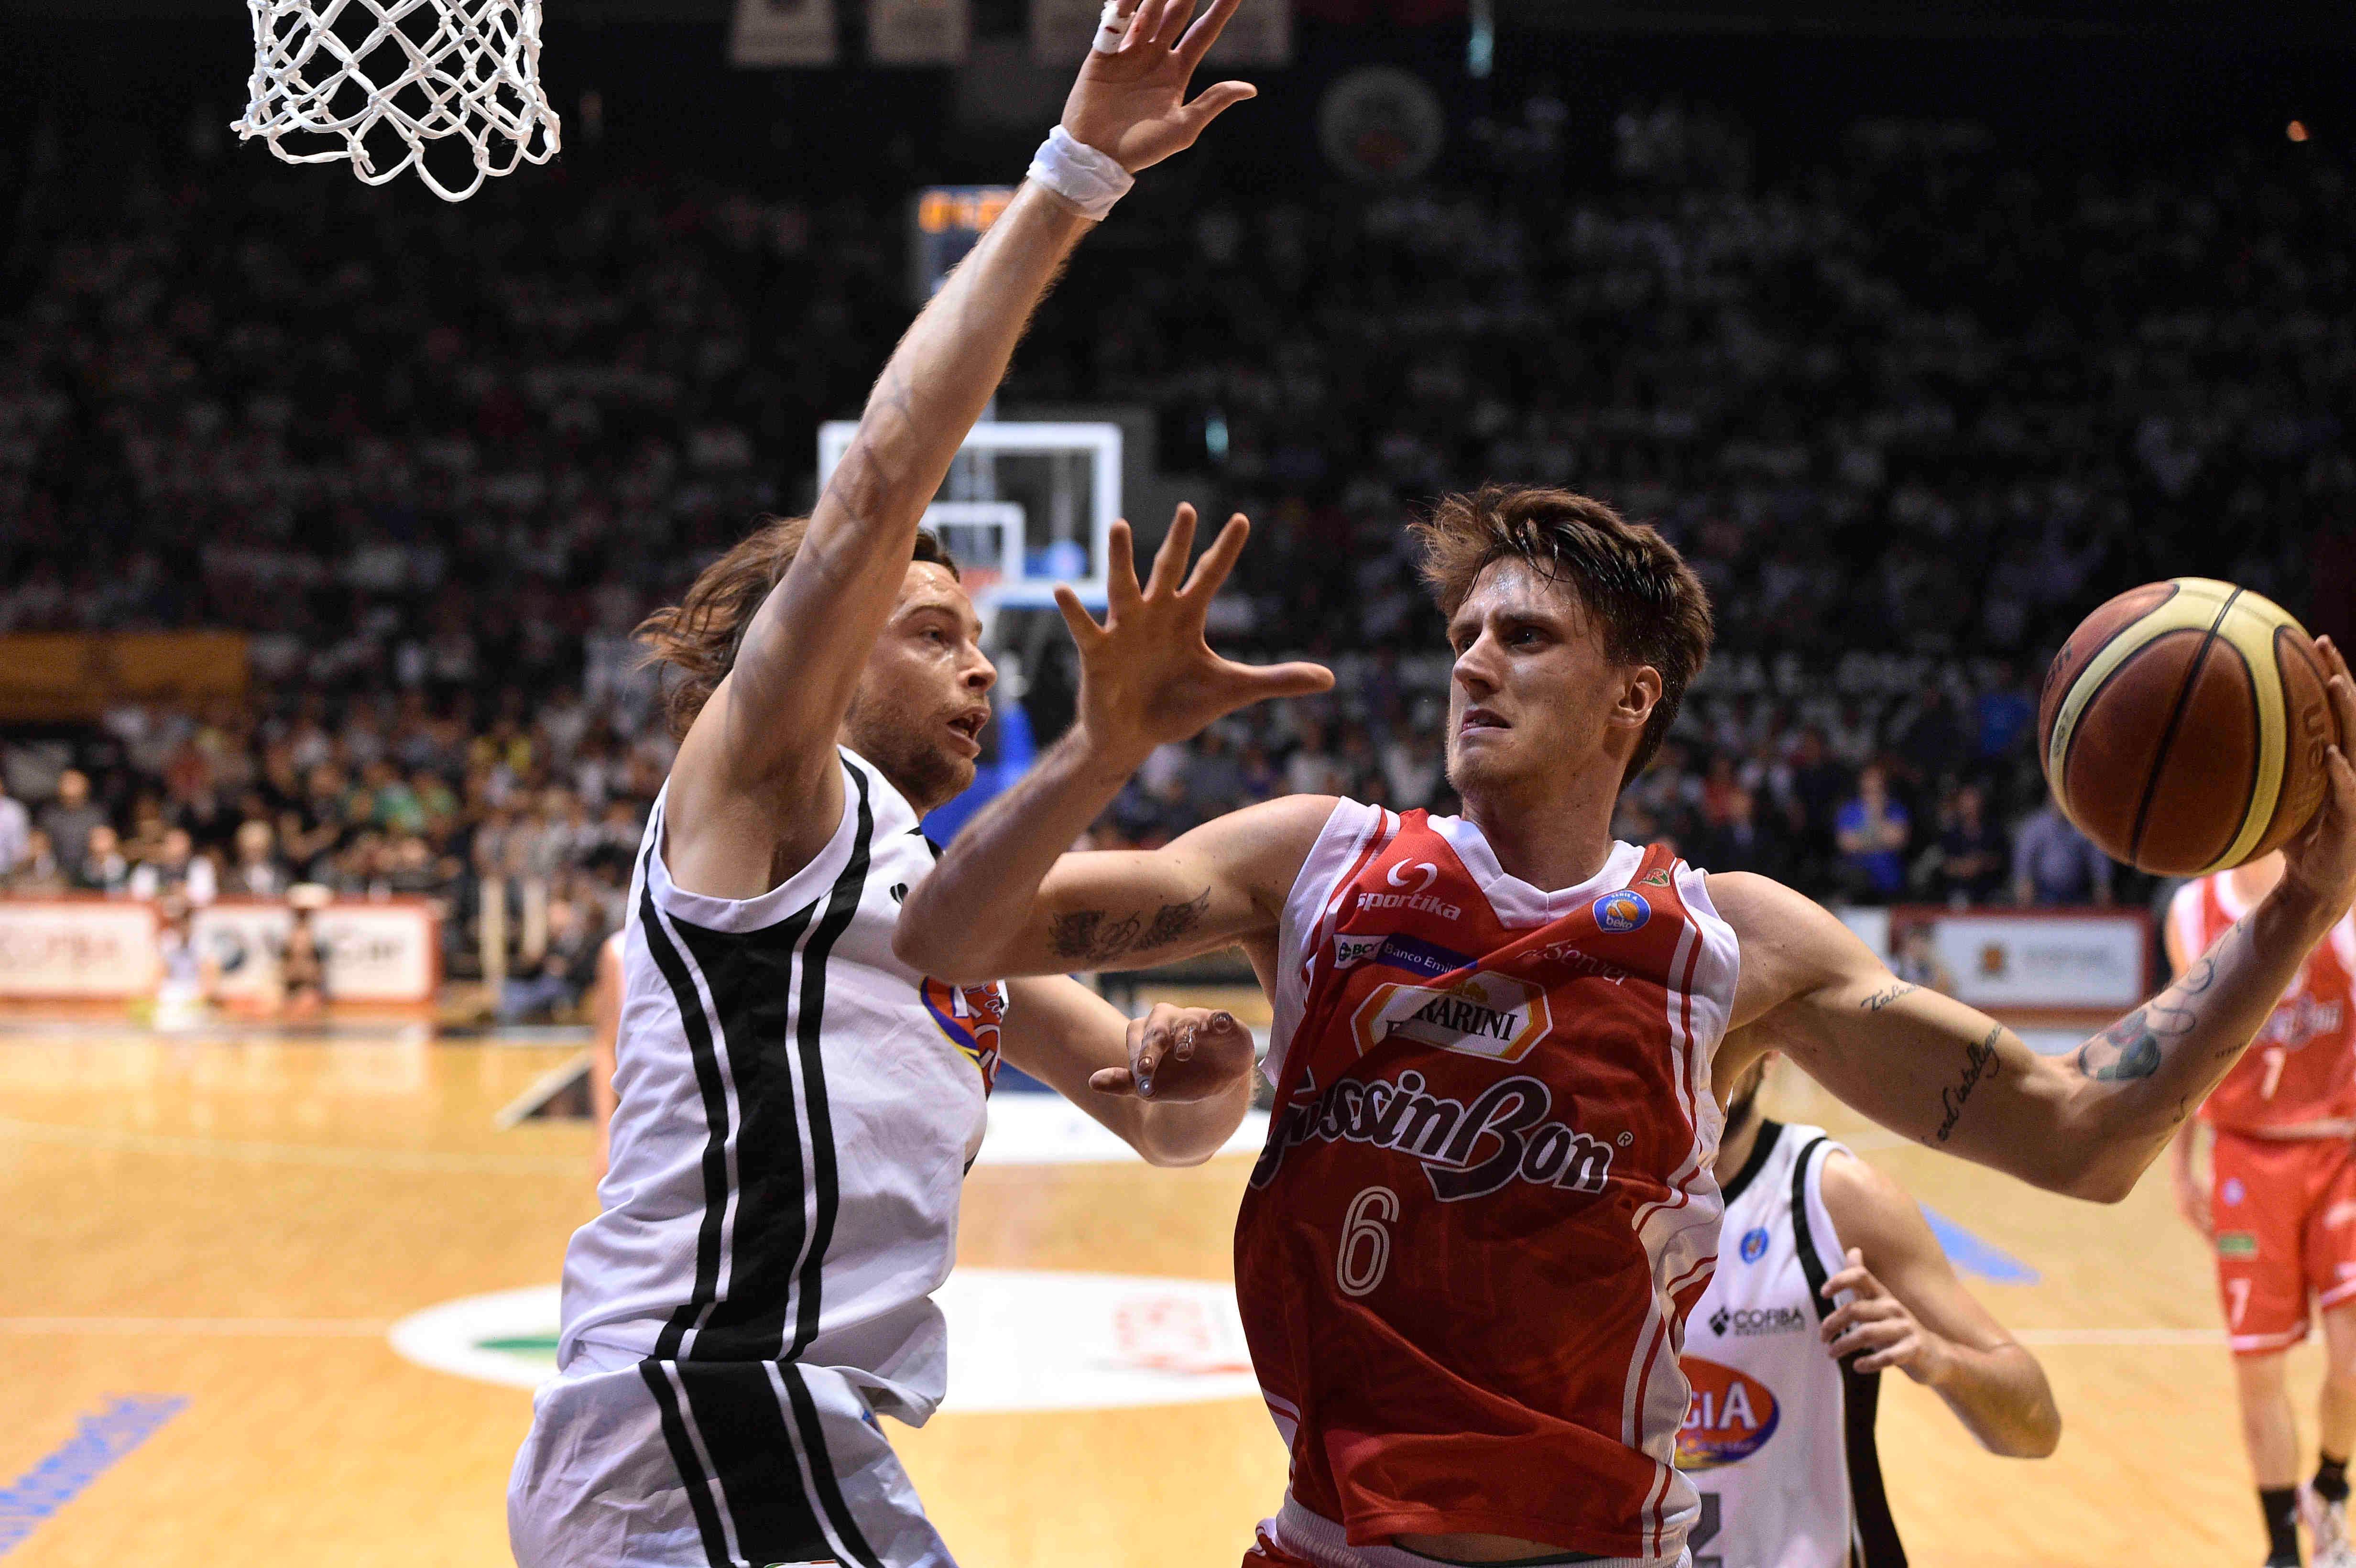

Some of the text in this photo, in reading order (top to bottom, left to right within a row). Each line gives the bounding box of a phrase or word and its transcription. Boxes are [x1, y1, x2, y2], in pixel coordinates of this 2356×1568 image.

[1356, 892, 1461, 921] sportika
[1606, 915, 1633, 928] beko
[1384, 942, 1422, 963] Banco
[1386, 997, 1518, 1041] FRARINI
[1337, 1186, 1400, 1296] 6
[1681, 1381, 1759, 1429] GIA
